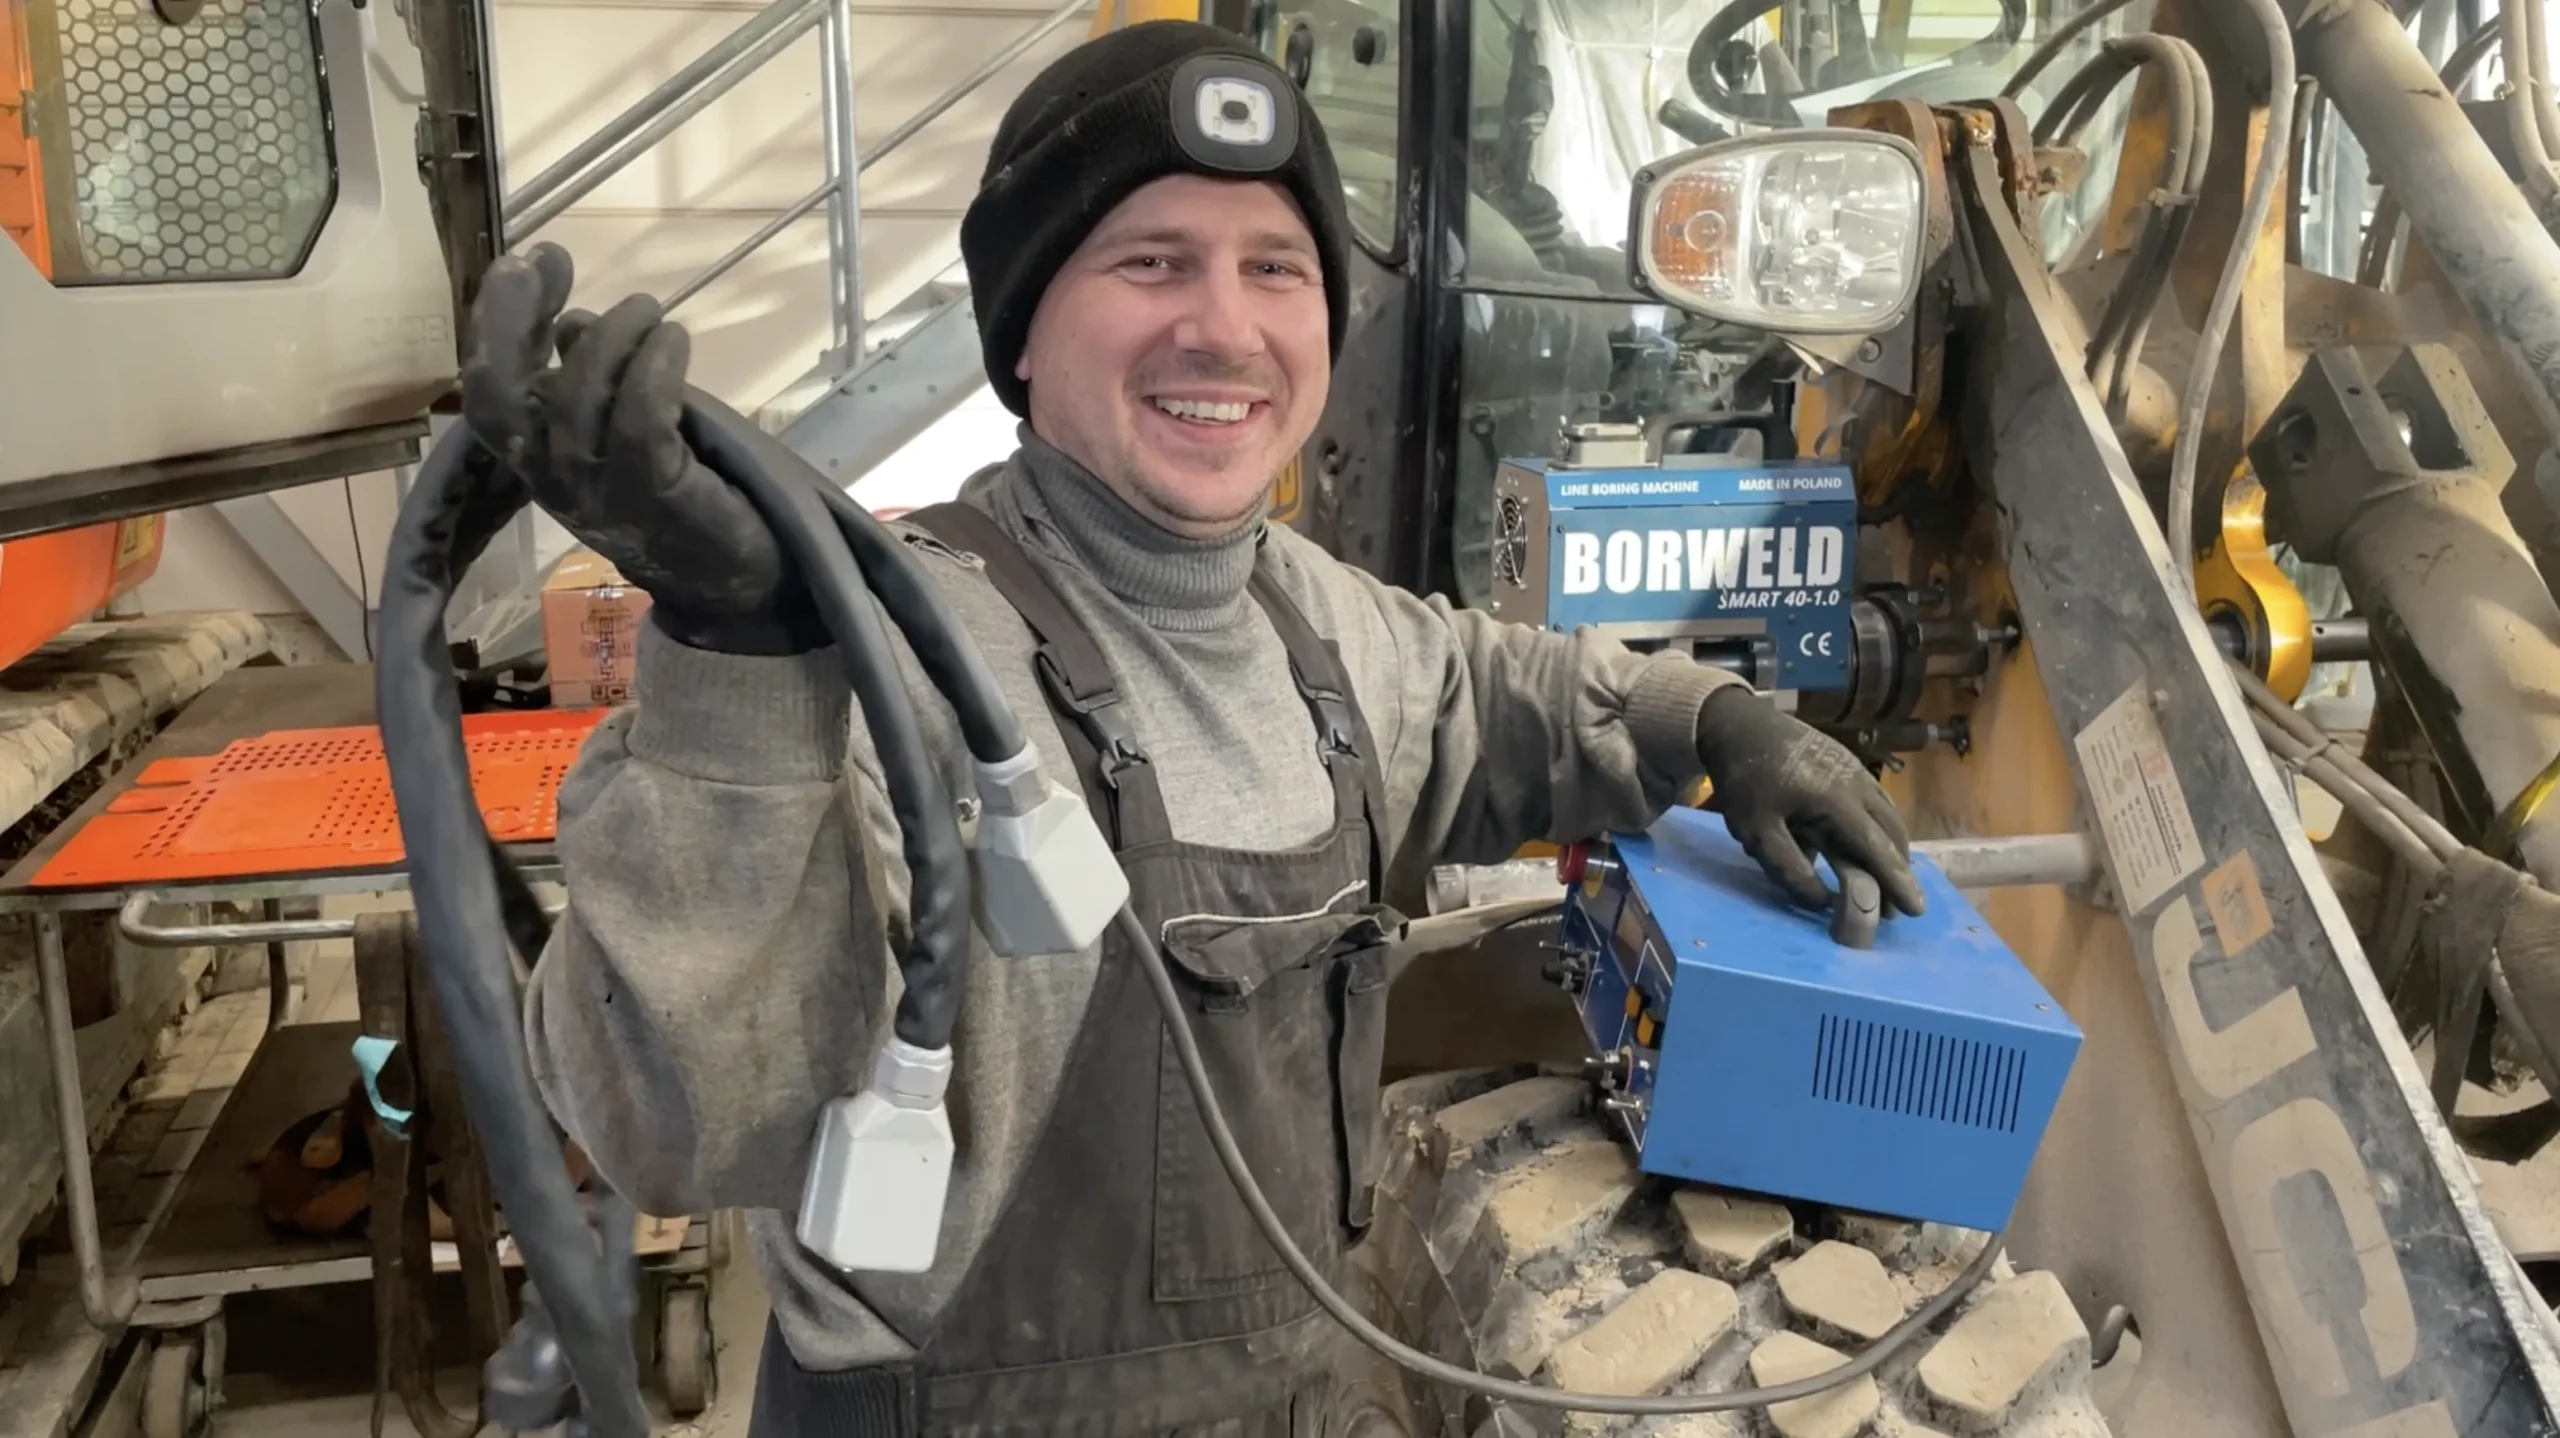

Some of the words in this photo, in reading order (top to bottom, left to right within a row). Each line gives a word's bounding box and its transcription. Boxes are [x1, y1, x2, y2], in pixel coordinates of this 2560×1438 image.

[1560, 483, 1589, 497] LINE
[1591, 481, 1640, 495] BORING
[1642, 480, 1699, 494] MACHINE
[1738, 479, 1773, 491] MADE
[1776, 479, 1790, 490] IN
[1793, 477, 1842, 489] POLAND
[1563, 526, 1844, 594] BORWELD
[1717, 591, 1781, 609] SMART
[1783, 589, 1840, 607] 40-1.0
